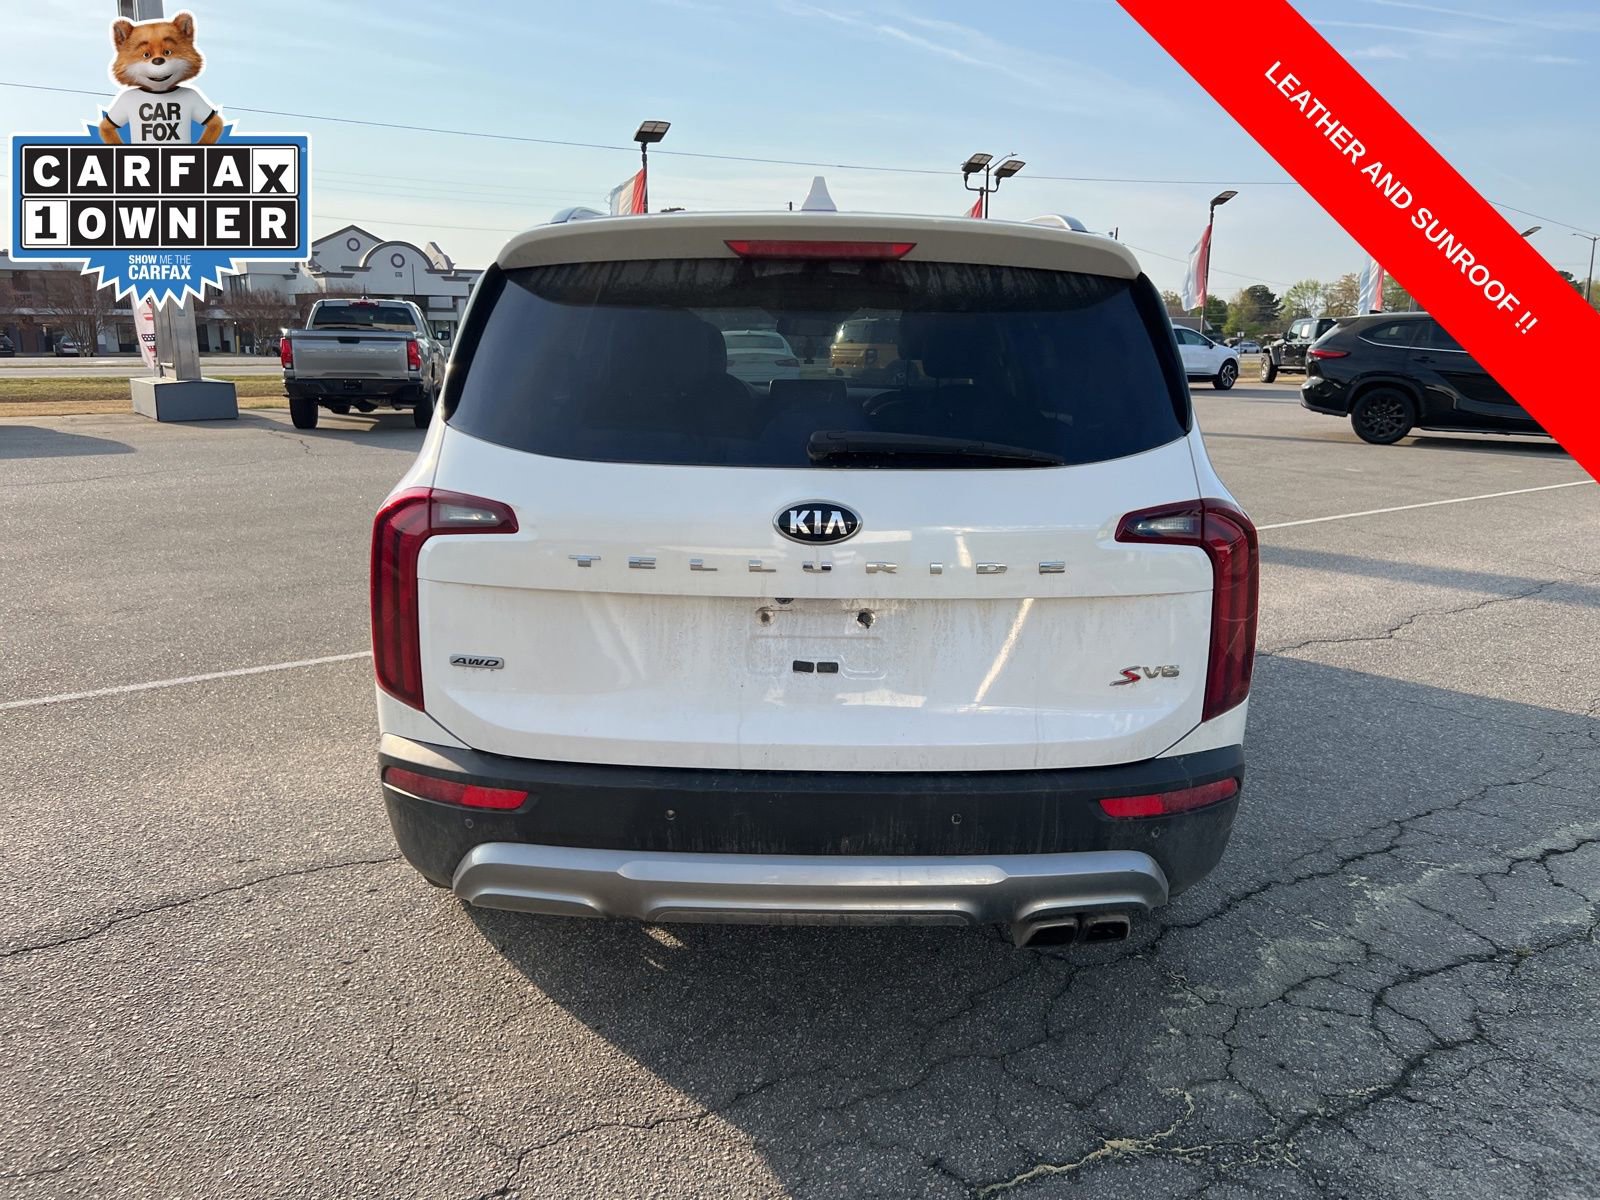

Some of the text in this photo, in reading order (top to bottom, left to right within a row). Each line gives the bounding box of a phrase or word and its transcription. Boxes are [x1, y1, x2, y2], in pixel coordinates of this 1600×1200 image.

[788, 509, 848, 535] KIA
[568, 554, 1066, 576] TELLURIDE
[451, 656, 501, 668] AWD
